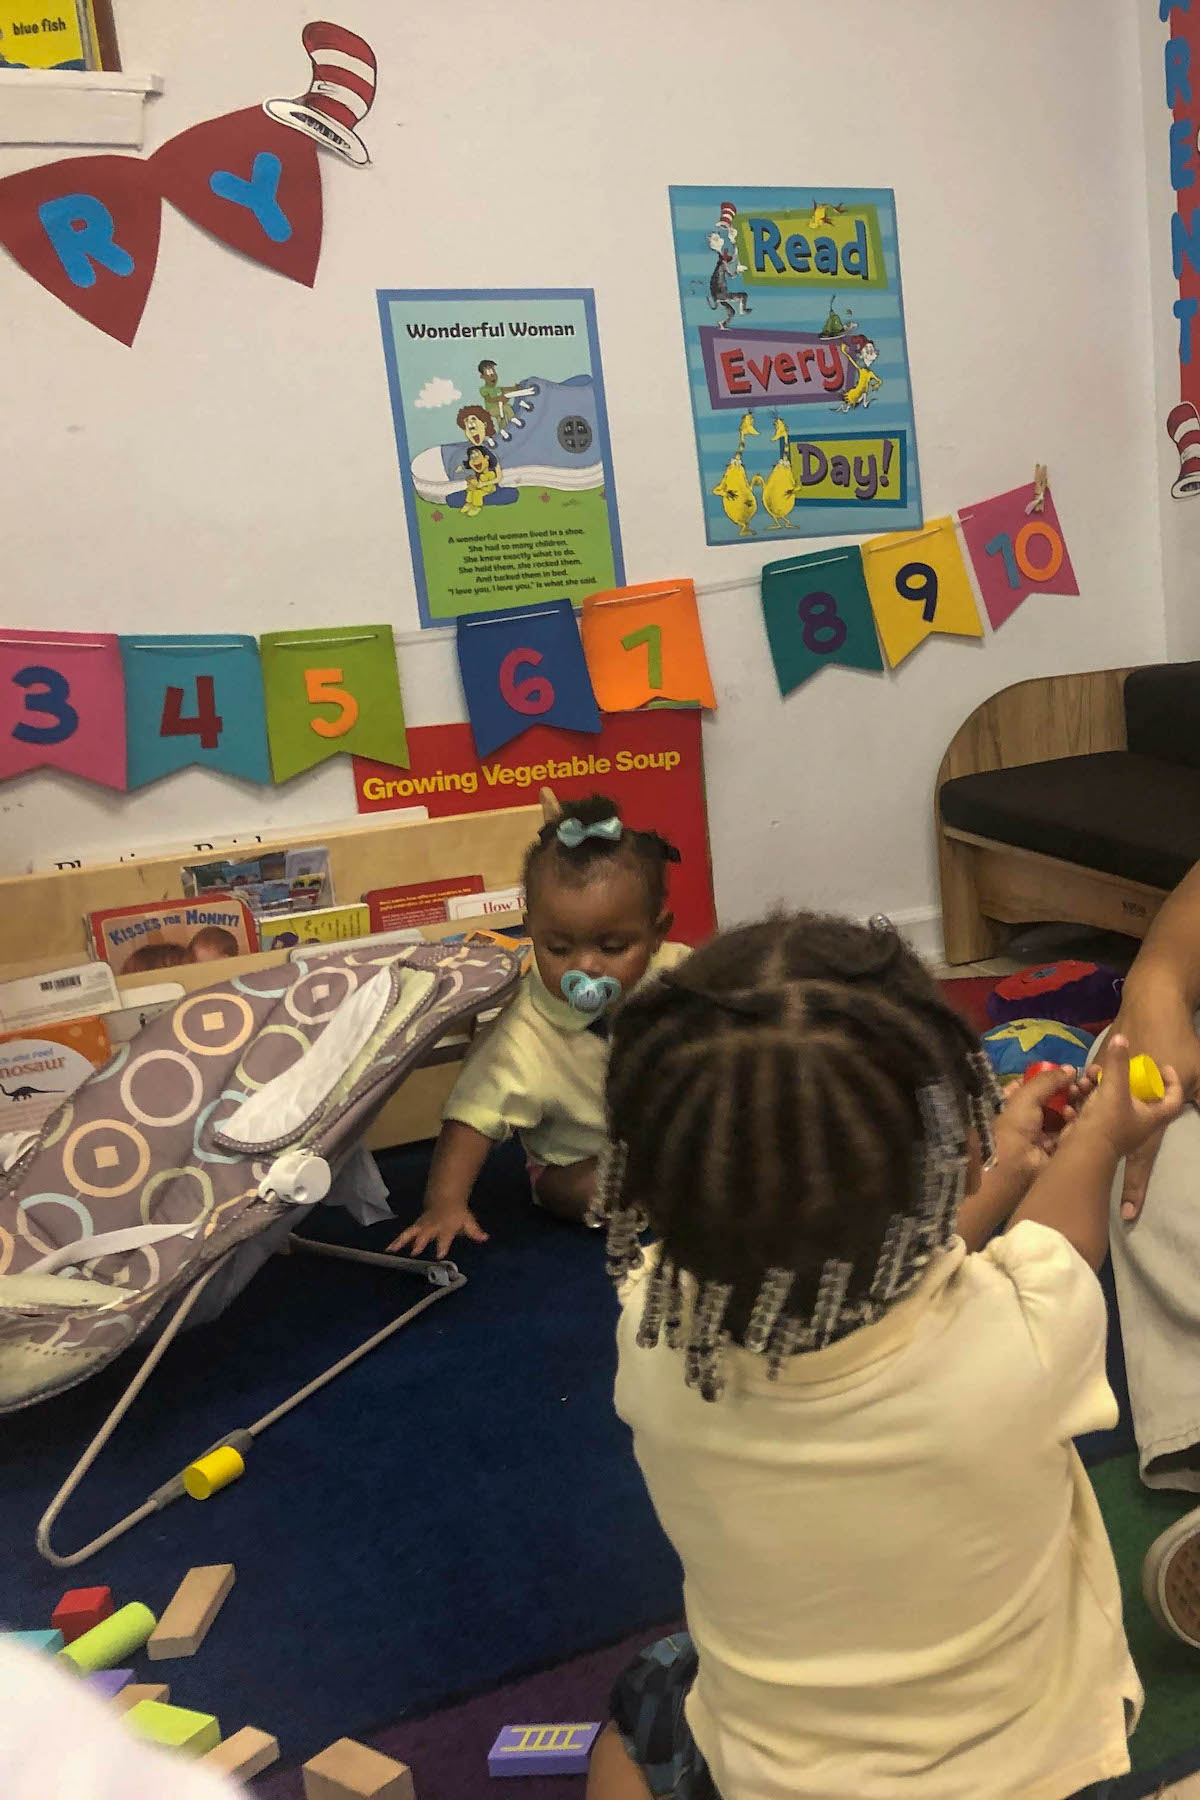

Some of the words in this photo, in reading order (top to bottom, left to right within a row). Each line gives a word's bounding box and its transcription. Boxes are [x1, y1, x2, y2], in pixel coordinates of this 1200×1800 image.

[12, 21, 39, 36] blue
[41, 17, 67, 32] fish
[748, 218, 869, 281] Read
[406, 321, 505, 339] Wonderful
[508, 322, 576, 337] Woman
[719, 342, 845, 395] Every
[797, 439, 894, 501] Day!
[456, 533, 498, 543] wonderful
[499, 532, 528, 540] woman
[529, 530, 548, 538] lived
[468, 545, 483, 553] She
[512, 542, 534, 550] many
[535, 540, 568, 548] children.
[464, 555, 478, 563] She
[480, 554, 501, 562] knew
[502, 552, 532, 561] exactly
[533, 550, 553, 558] what
[458, 566, 474, 574] She
[474, 564, 493, 572] held
[532, 560, 560, 568] rocked
[455, 588, 473, 596] love
[496, 584, 514, 592] love
[544, 580, 564, 588] what
[565, 578, 579, 586] she
[476, 575, 493, 583] And
[494, 574, 520, 582] tucked
[11, 665, 80, 746] 3
[159, 675, 223, 749] 4
[304, 668, 360, 738] 5
[499, 647, 557, 717] 6
[620, 624, 663, 690] 7
[798, 591, 848, 655] 8
[895, 561, 938, 623] 9
[985, 520, 1063, 591] 10
[362, 769, 479, 800] Growing
[481, 754, 611, 788] Vegetable
[614, 749, 681, 773] Soup
[483, 901, 513, 914] How
[108, 917, 161, 946] KISSES
[163, 914, 182, 926] FOR
[185, 909, 240, 928] MOMMY!
